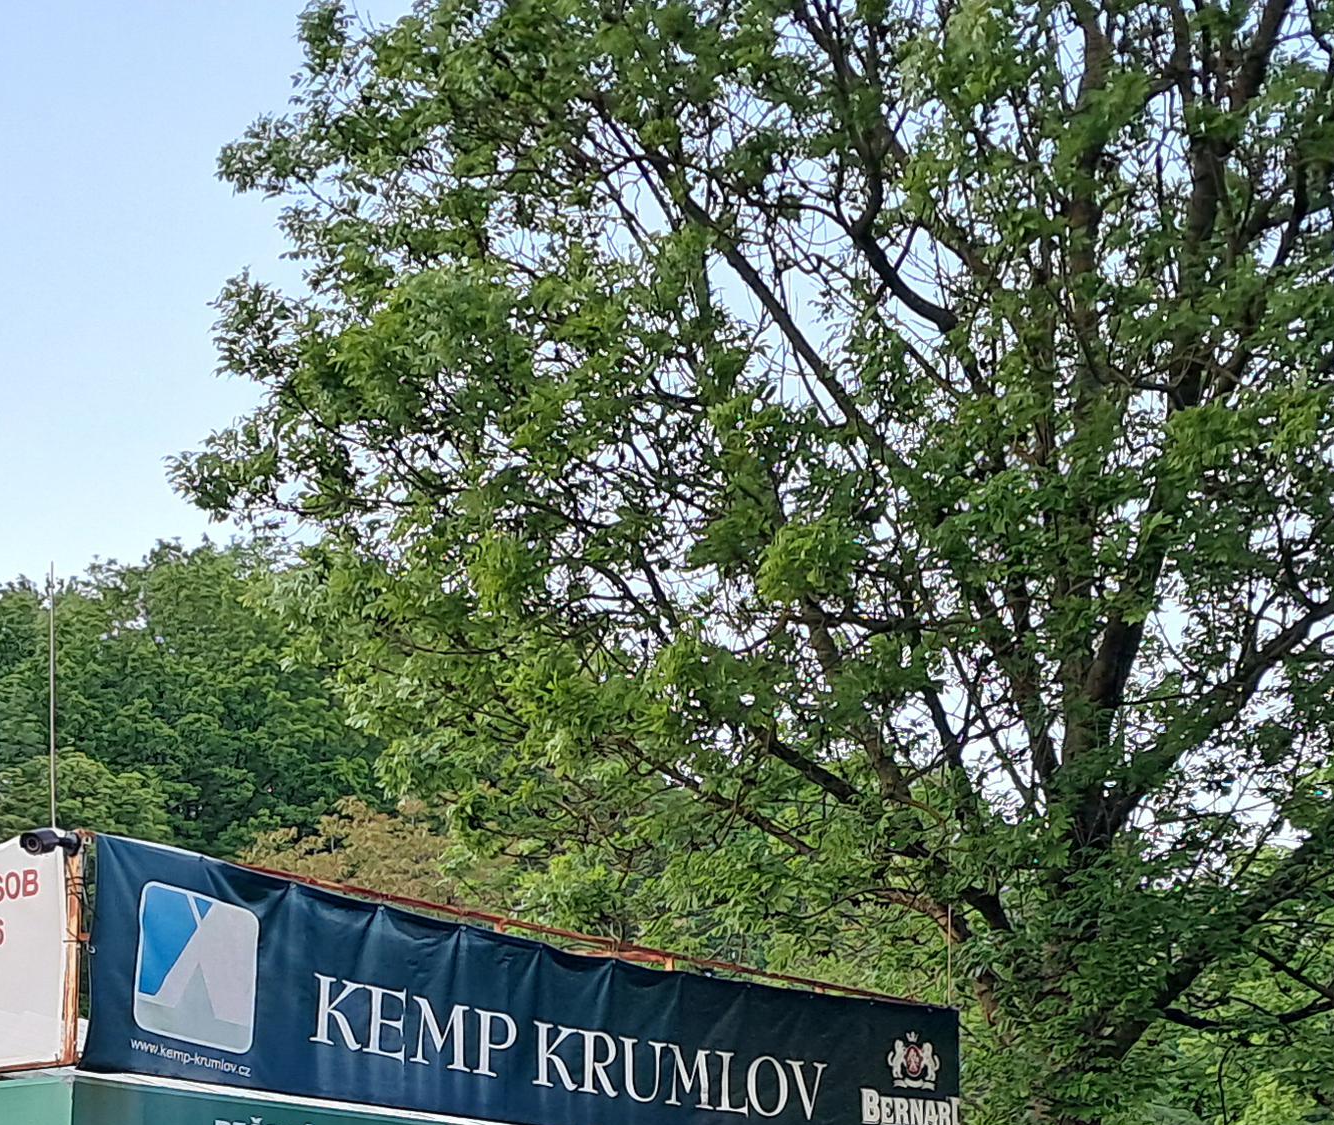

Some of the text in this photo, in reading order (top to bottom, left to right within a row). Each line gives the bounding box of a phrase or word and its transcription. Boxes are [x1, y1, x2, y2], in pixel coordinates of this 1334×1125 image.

[130, 1038, 251, 1077] www.kemp-krumlov.cz
[309, 972, 828, 1121] KEMP KRUMLOV
